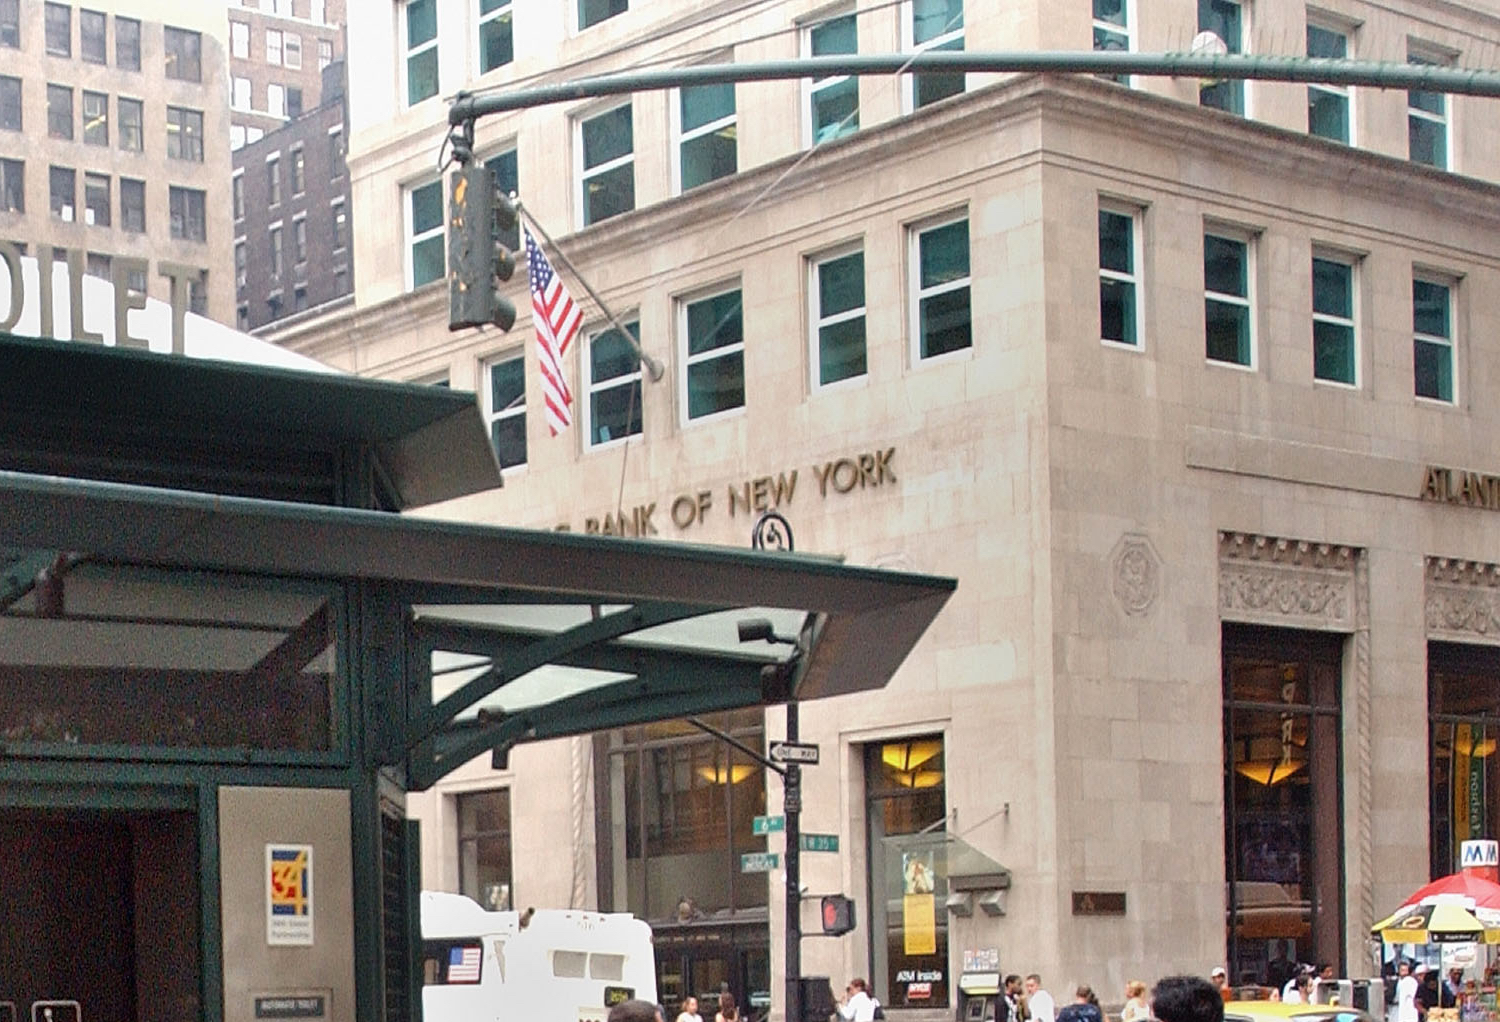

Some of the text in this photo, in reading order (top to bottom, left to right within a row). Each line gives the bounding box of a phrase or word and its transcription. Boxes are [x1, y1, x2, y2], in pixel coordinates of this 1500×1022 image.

[585, 446, 898, 538] BANK OF NEW YORK
